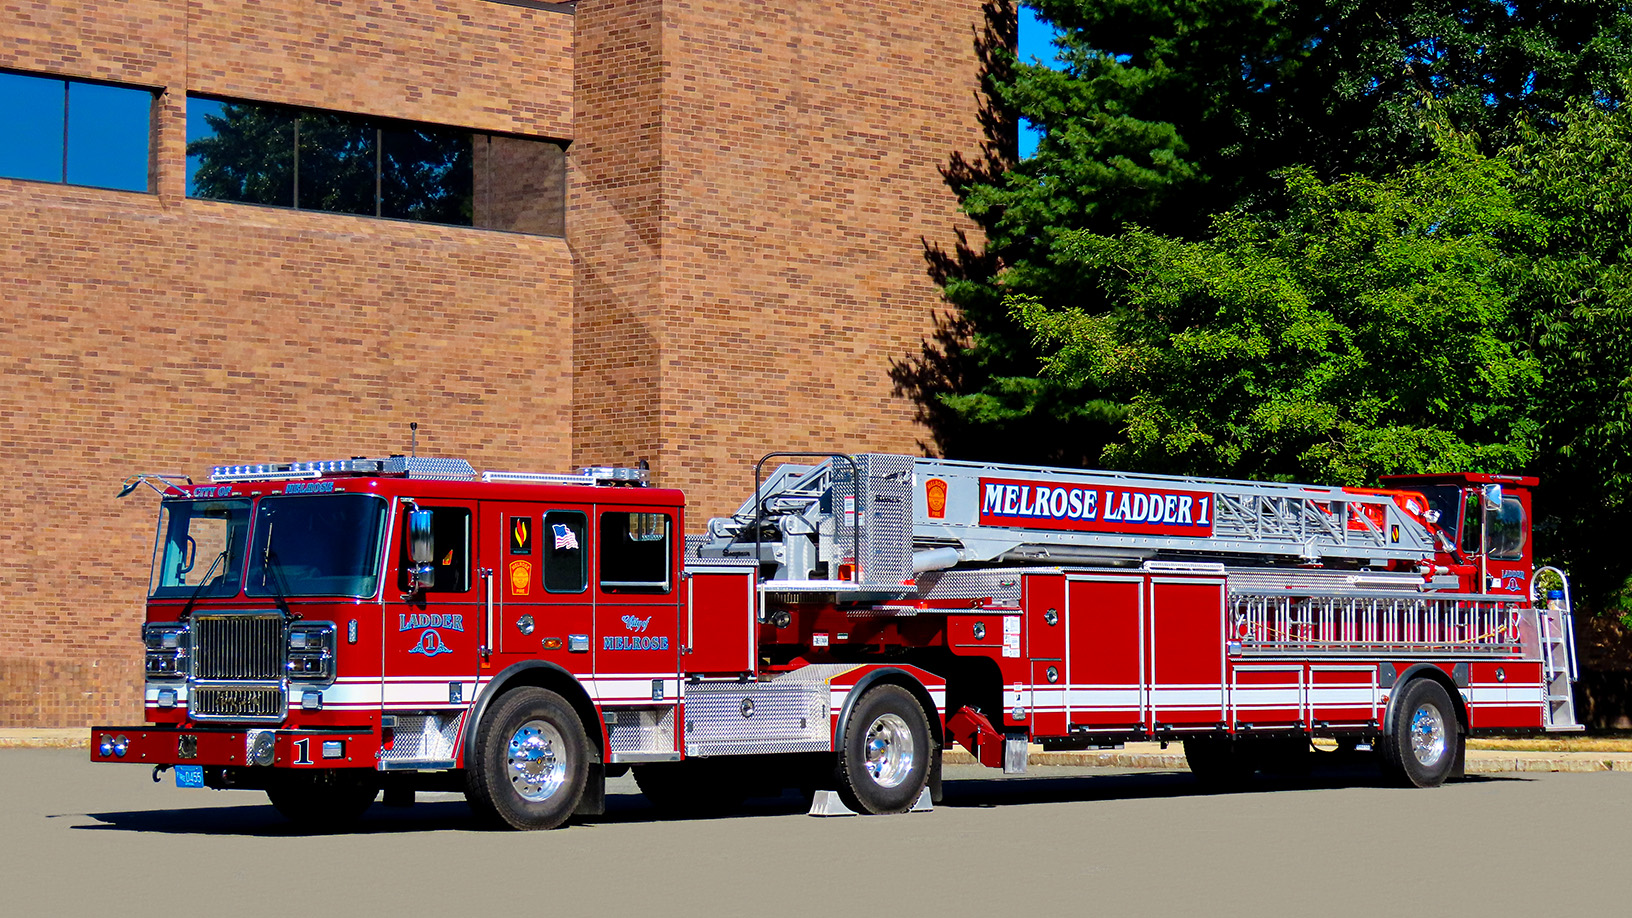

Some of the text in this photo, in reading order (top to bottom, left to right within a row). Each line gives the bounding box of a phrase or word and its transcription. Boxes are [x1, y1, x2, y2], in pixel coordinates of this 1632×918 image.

[193, 486, 232, 498] CITY OF
[285, 482, 335, 494] MELROSE
[982, 483, 1211, 527] MELROSE LADDER 1
[1501, 569, 1525, 580] LADDER
[399, 613, 465, 632] LADDER
[621, 615, 652, 632] City of
[426, 633, 436, 650] 1
[603, 636, 669, 650] MELROSE
[293, 737, 314, 765] 1
[185, 771, 202, 783] 0455
